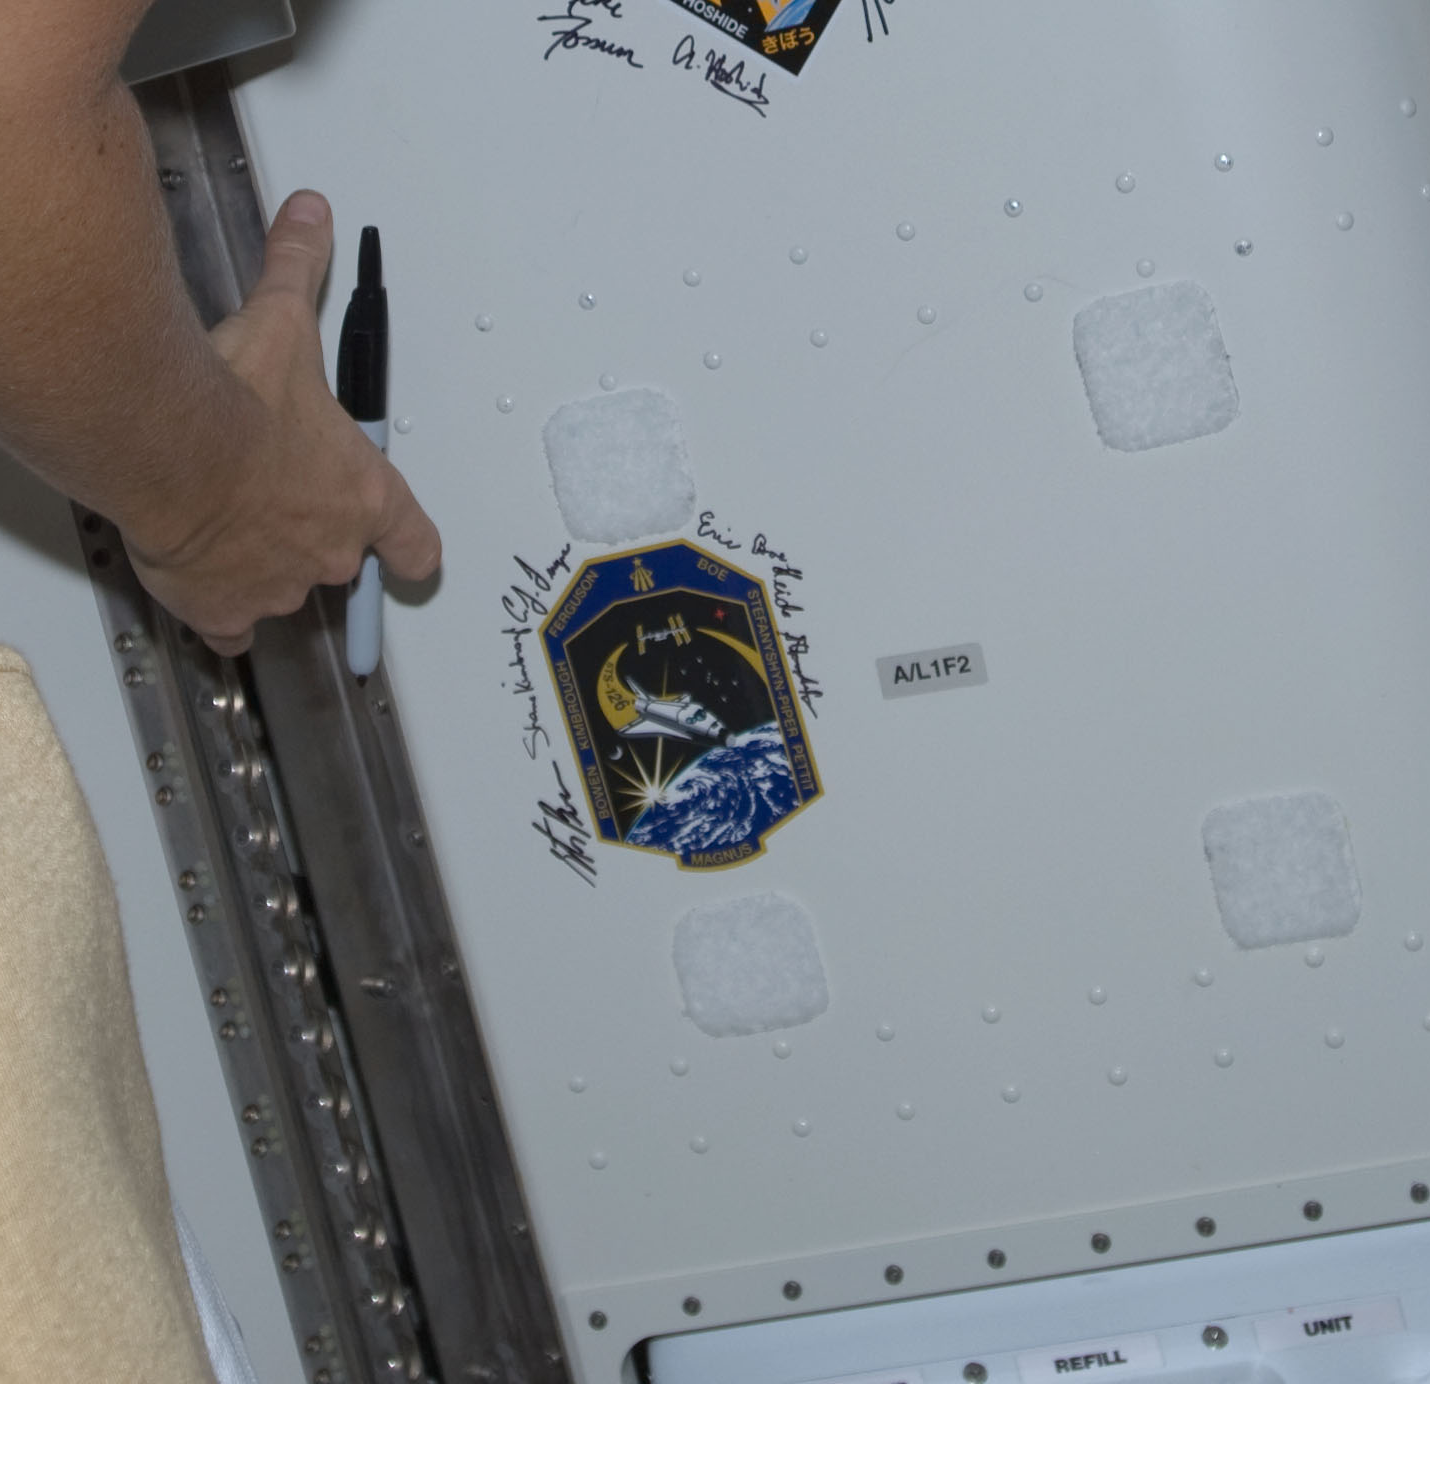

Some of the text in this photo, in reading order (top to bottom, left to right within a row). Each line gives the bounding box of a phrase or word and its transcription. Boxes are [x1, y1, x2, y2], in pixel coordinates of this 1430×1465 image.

[761, 26, 816, 56] きぼう
[696, 557, 730, 582] BOE
[548, 569, 599, 638] FERGUSON
[747, 588, 800, 739] STEFANYSHYN-PIPER
[892, 654, 973, 686] A/L1F2
[555, 661, 590, 751] KIMBROUGH
[603, 662, 630, 712] STS-126
[792, 743, 816, 792] PETTIT
[586, 764, 611, 820] BOWEN
[690, 842, 754, 867] MAGNUS
[1302, 1315, 1355, 1338] UNIT
[1054, 1349, 1128, 1375] REFILL
